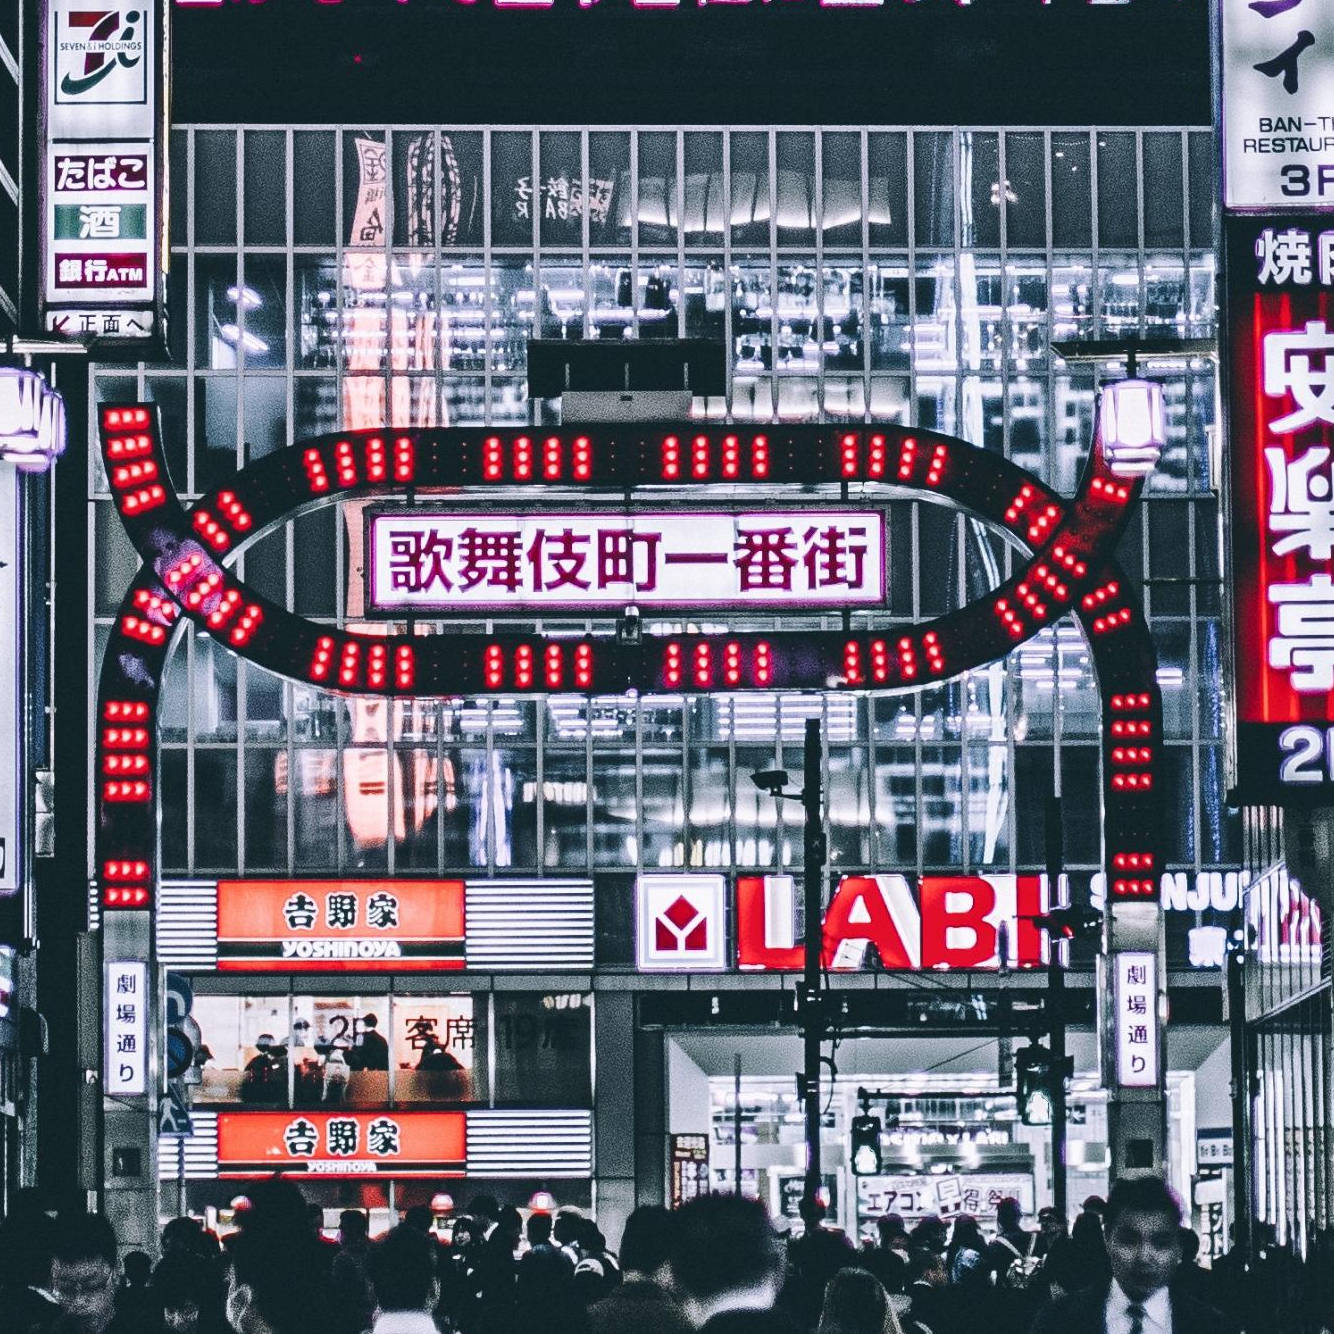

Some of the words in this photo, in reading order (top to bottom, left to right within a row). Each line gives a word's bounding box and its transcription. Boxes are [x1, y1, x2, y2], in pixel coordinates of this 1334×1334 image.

[56, 157, 146, 191] たばこ
[79, 205, 122, 239] 酒
[59, 259, 143, 283] 銀行ATM
[79, 313, 144, 334] 正面へ
[388, 525, 868, 593] 歌舞伎町一番街
[283, 891, 400, 929] 吉野家
[281, 940, 402, 958] YOSHINOYA
[116, 973, 138, 1083] 劇場通り
[1126, 965, 1149, 1074] 劇場通り
[283, 1118, 401, 1156] 吉野家
[307, 1161, 378, 1174] YOSHINOYA
